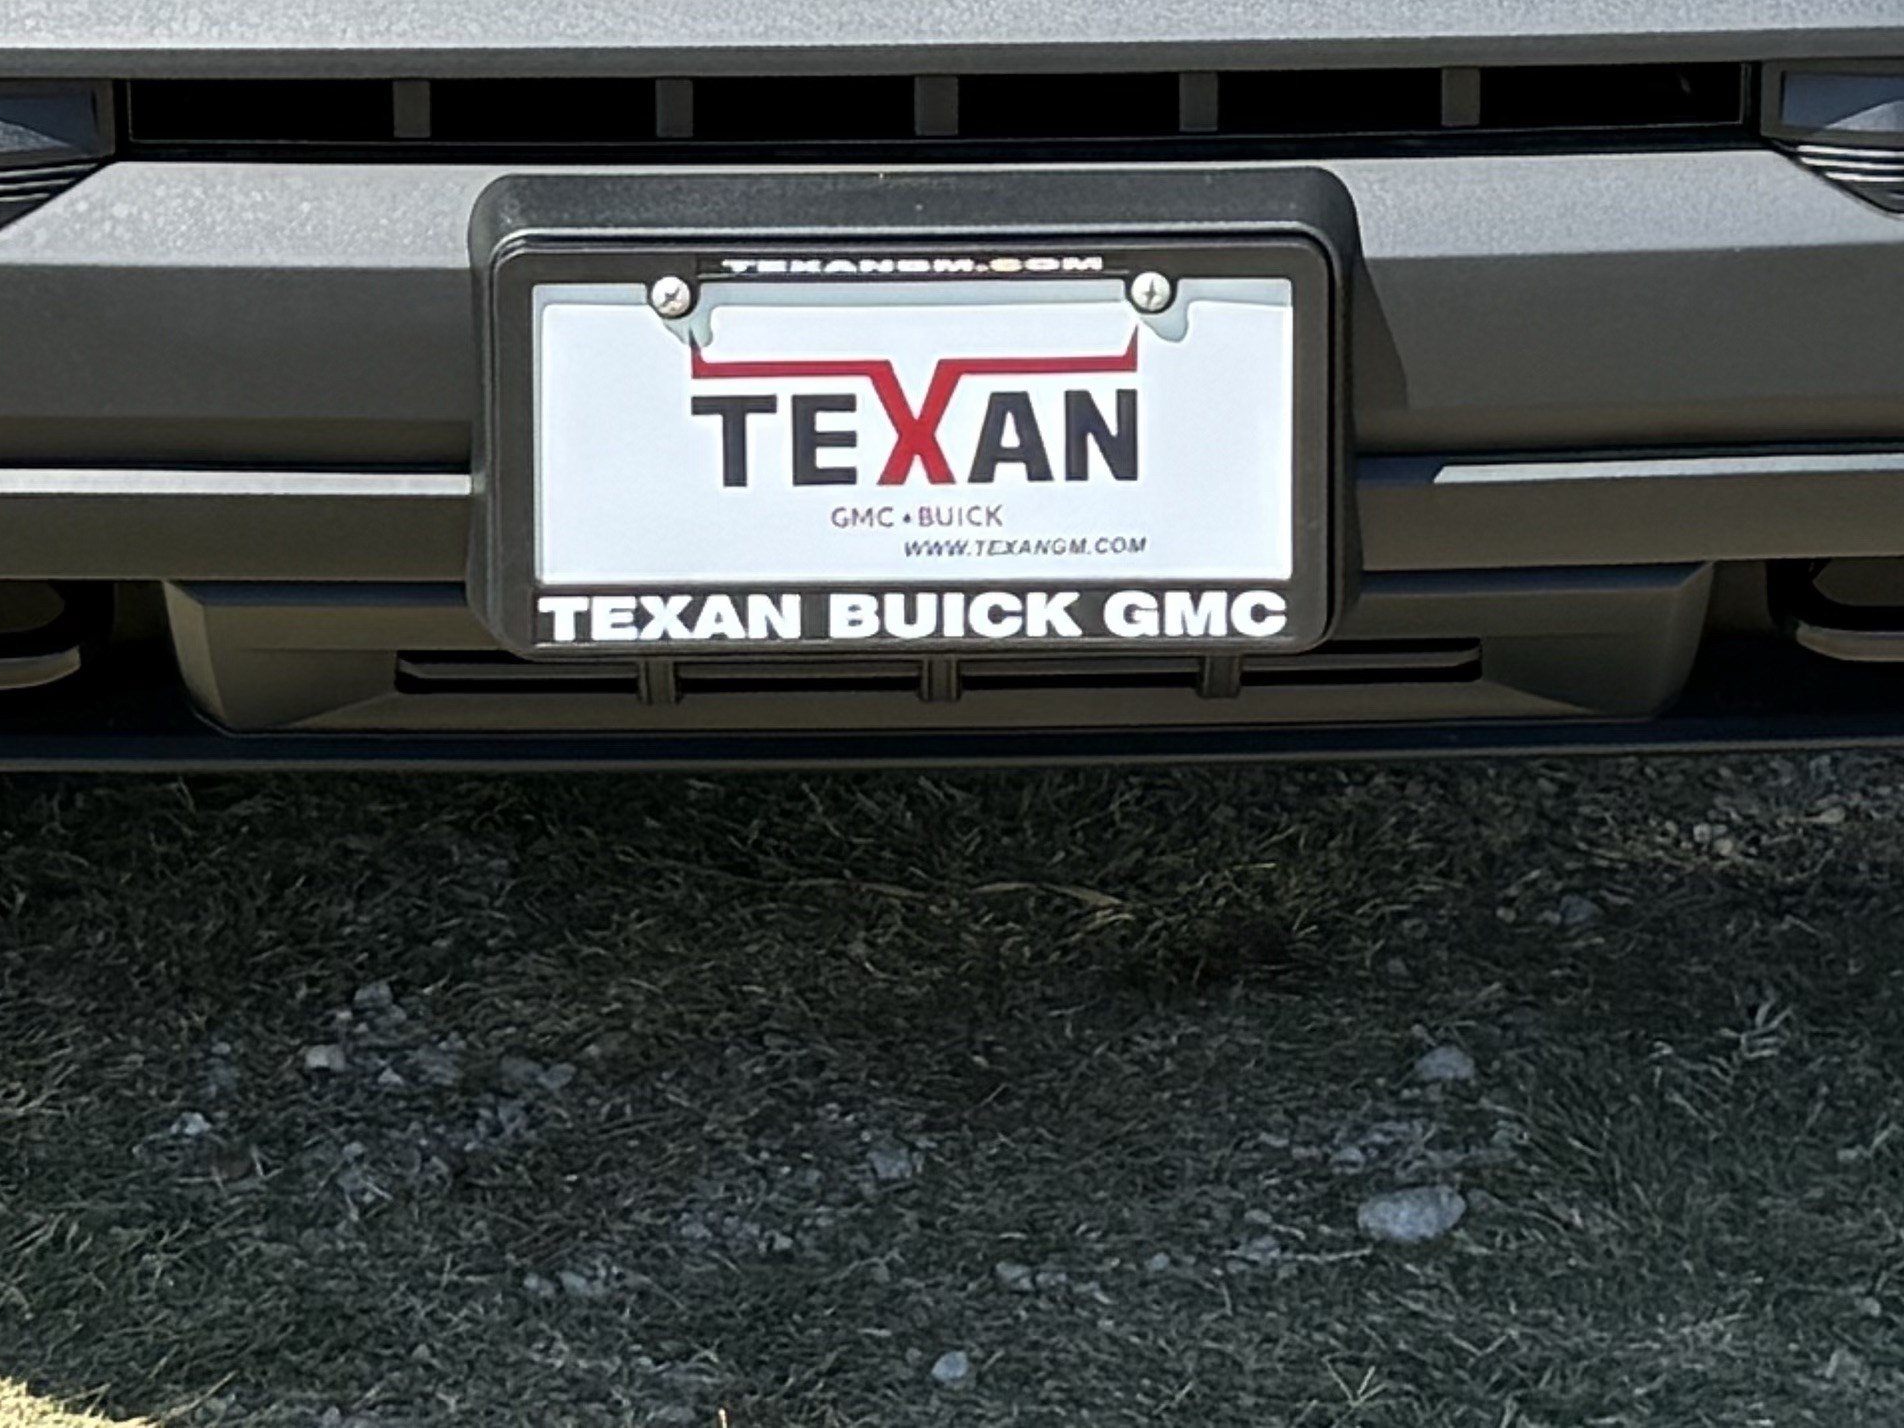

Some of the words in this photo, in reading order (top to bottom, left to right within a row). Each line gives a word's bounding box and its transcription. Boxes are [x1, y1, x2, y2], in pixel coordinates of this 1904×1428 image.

[691, 360, 1139, 488] TEXAN
[830, 506, 895, 529] GMC
[917, 504, 1004, 528] BUICK
[904, 536, 1147, 557] WWW.TEXANGM.COM
[537, 595, 803, 644] TEXAN
[828, 592, 1083, 640] BUICK
[1102, 590, 1288, 639] GMC
